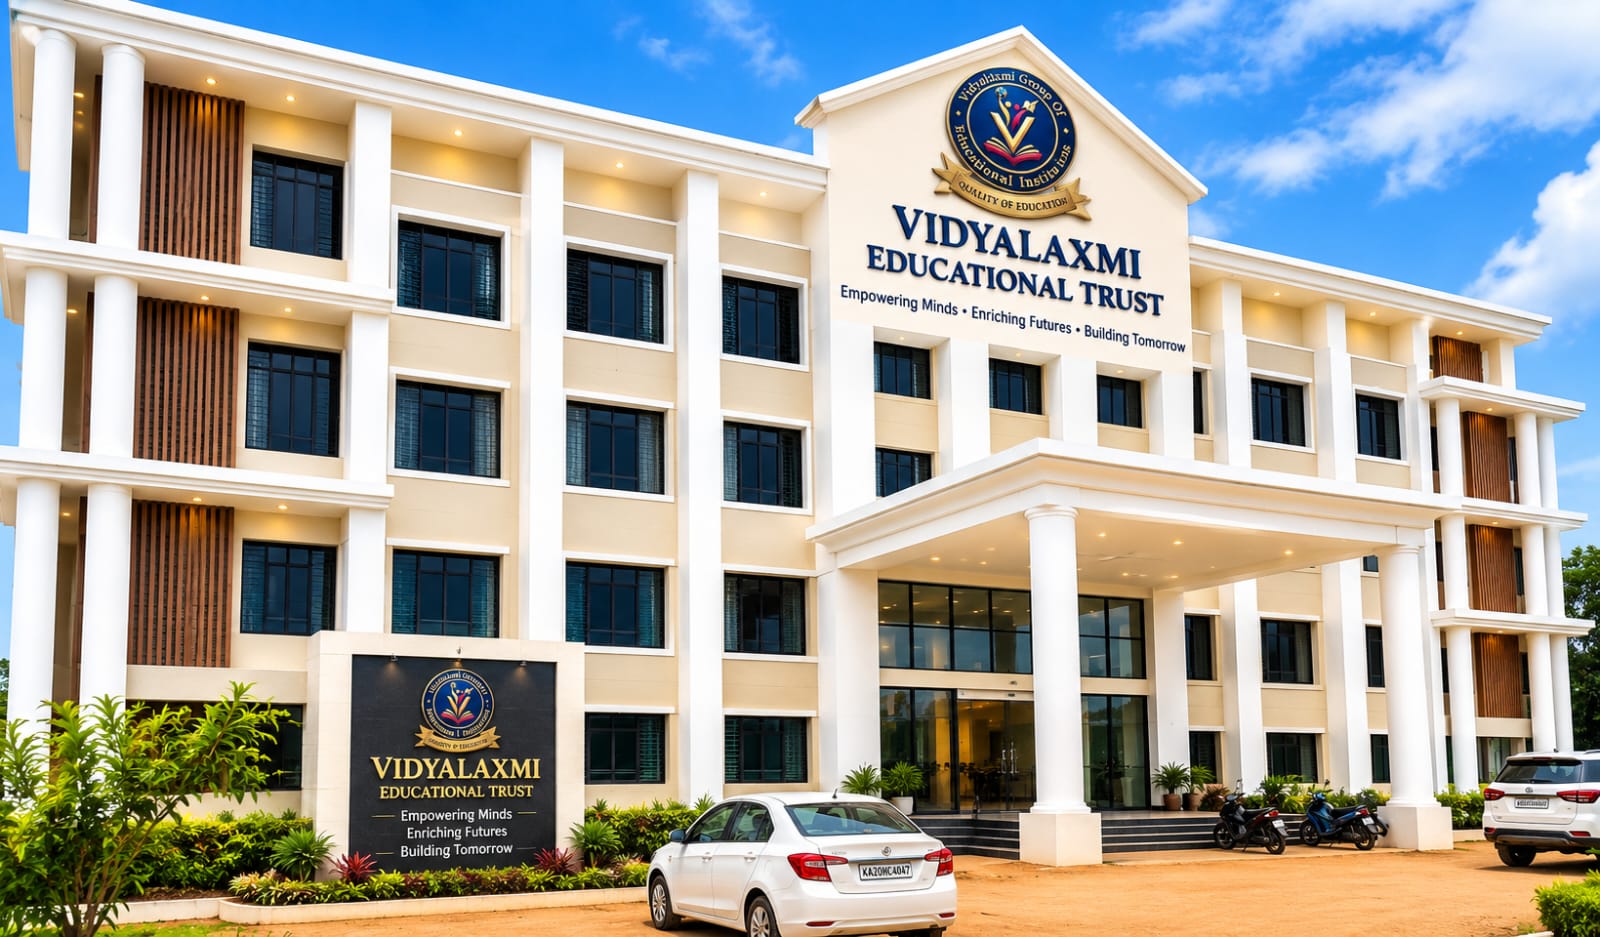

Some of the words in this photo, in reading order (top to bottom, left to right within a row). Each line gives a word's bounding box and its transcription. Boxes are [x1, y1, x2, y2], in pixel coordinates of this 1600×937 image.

[1018, 74, 1053, 101] Group
[1052, 101, 1068, 117] Of
[954, 125, 1013, 187] Educational
[958, 180, 999, 205] QUALITY
[1000, 199, 1014, 209] OF
[1016, 197, 1068, 212] EDUCATION
[892, 204, 1142, 280] VIDYALAXMI
[866, 244, 1074, 302] EDUCATIONAL
[1079, 280, 1164, 317] TRUST
[840, 284, 918, 313] Empowering
[921, 297, 959, 316] Minds
[971, 305, 1026, 330] Enriching
[1029, 314, 1073, 335] Futures
[1084, 324, 1130, 347] Building
[1132, 332, 1186, 353] Tomorrow
[370, 756, 541, 780] VIDYALAXMI
[379, 785, 485, 800] EDUCATIONAL
[488, 784, 534, 798] TRUST
[401, 809, 475, 824] Empowering
[478, 808, 513, 820] Minds
[407, 827, 462, 840] Enriching
[465, 826, 508, 838] Futures
[400, 845, 451, 859] Building
[453, 844, 513, 856] Tomorrow
